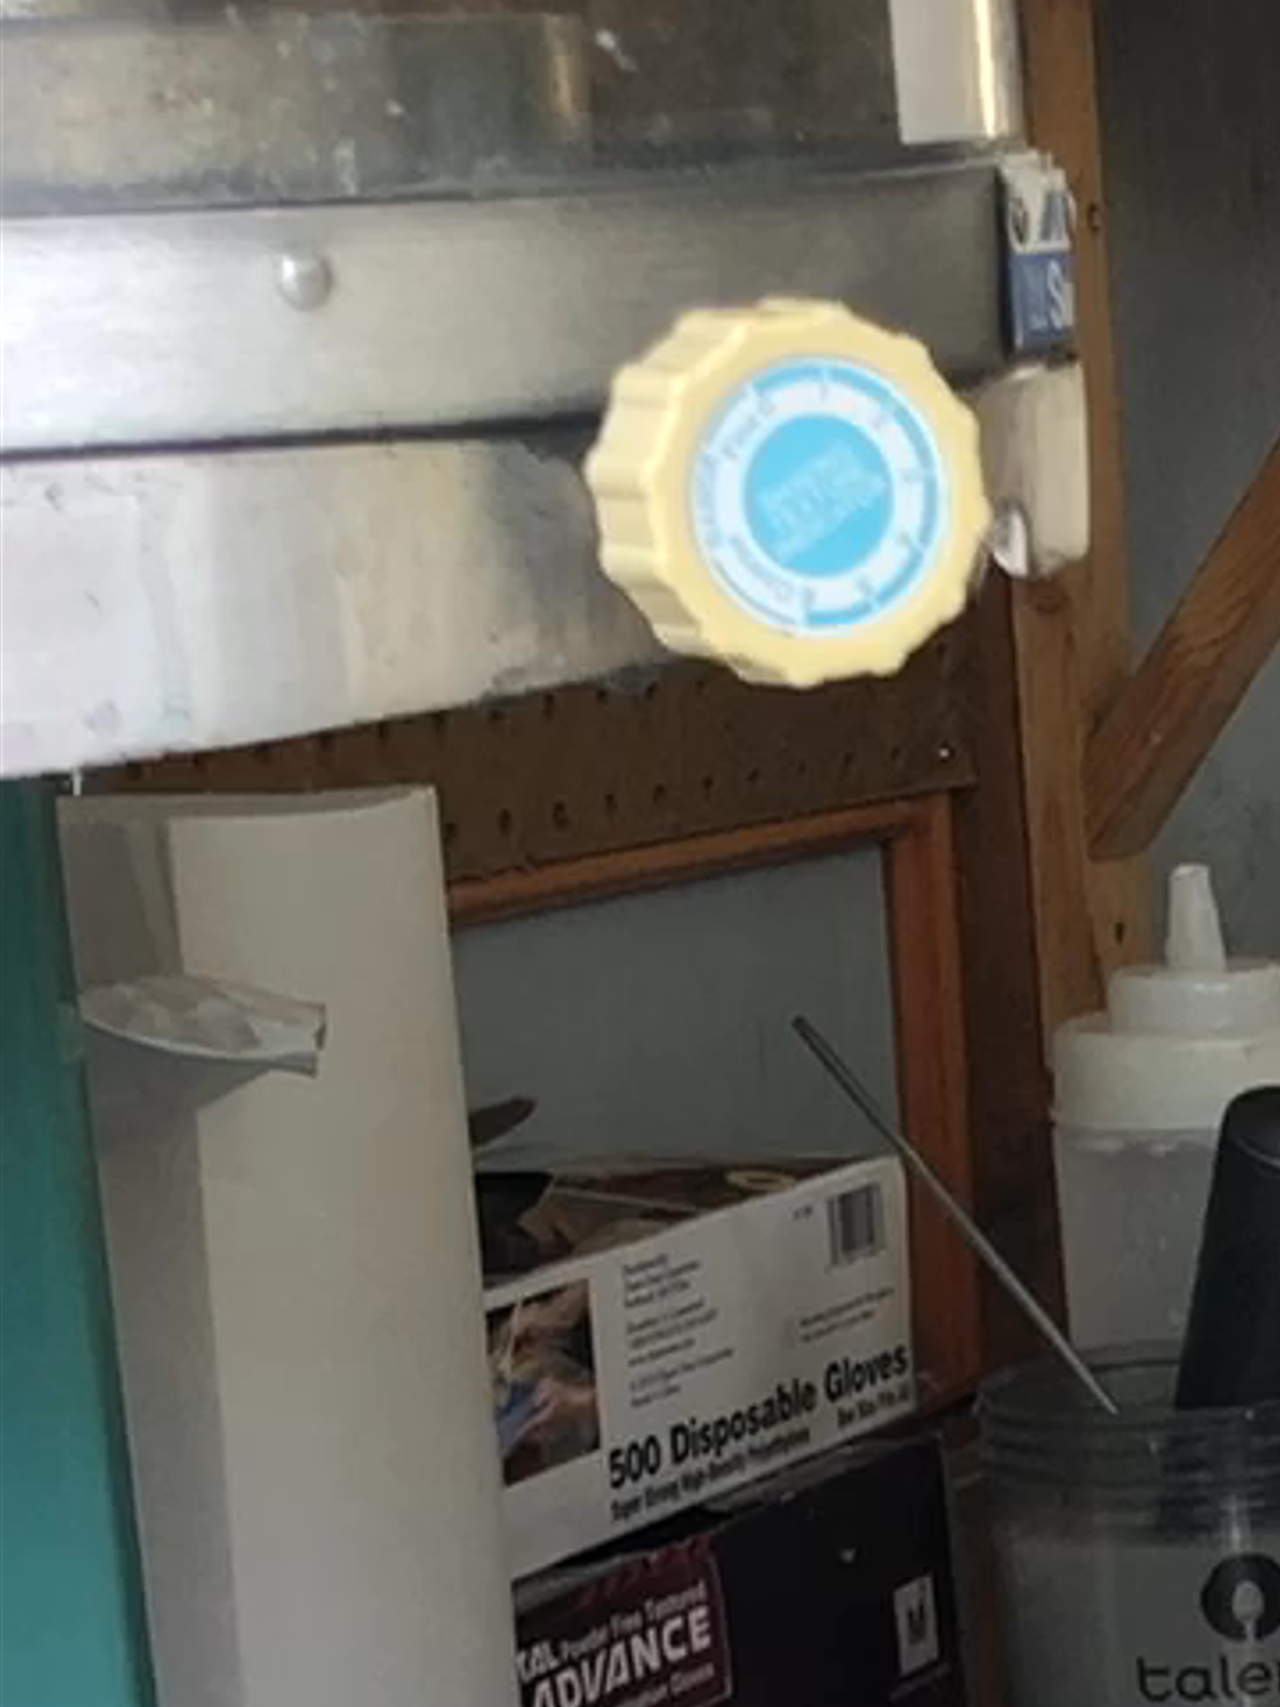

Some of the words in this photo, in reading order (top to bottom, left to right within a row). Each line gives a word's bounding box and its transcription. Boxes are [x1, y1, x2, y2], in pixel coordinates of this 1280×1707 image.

[608, 1436, 661, 1489] 500
[671, 1380, 817, 1463] Disposable
[824, 1346, 908, 1402] Gloves
[907, 1603, 928, 1646] M
